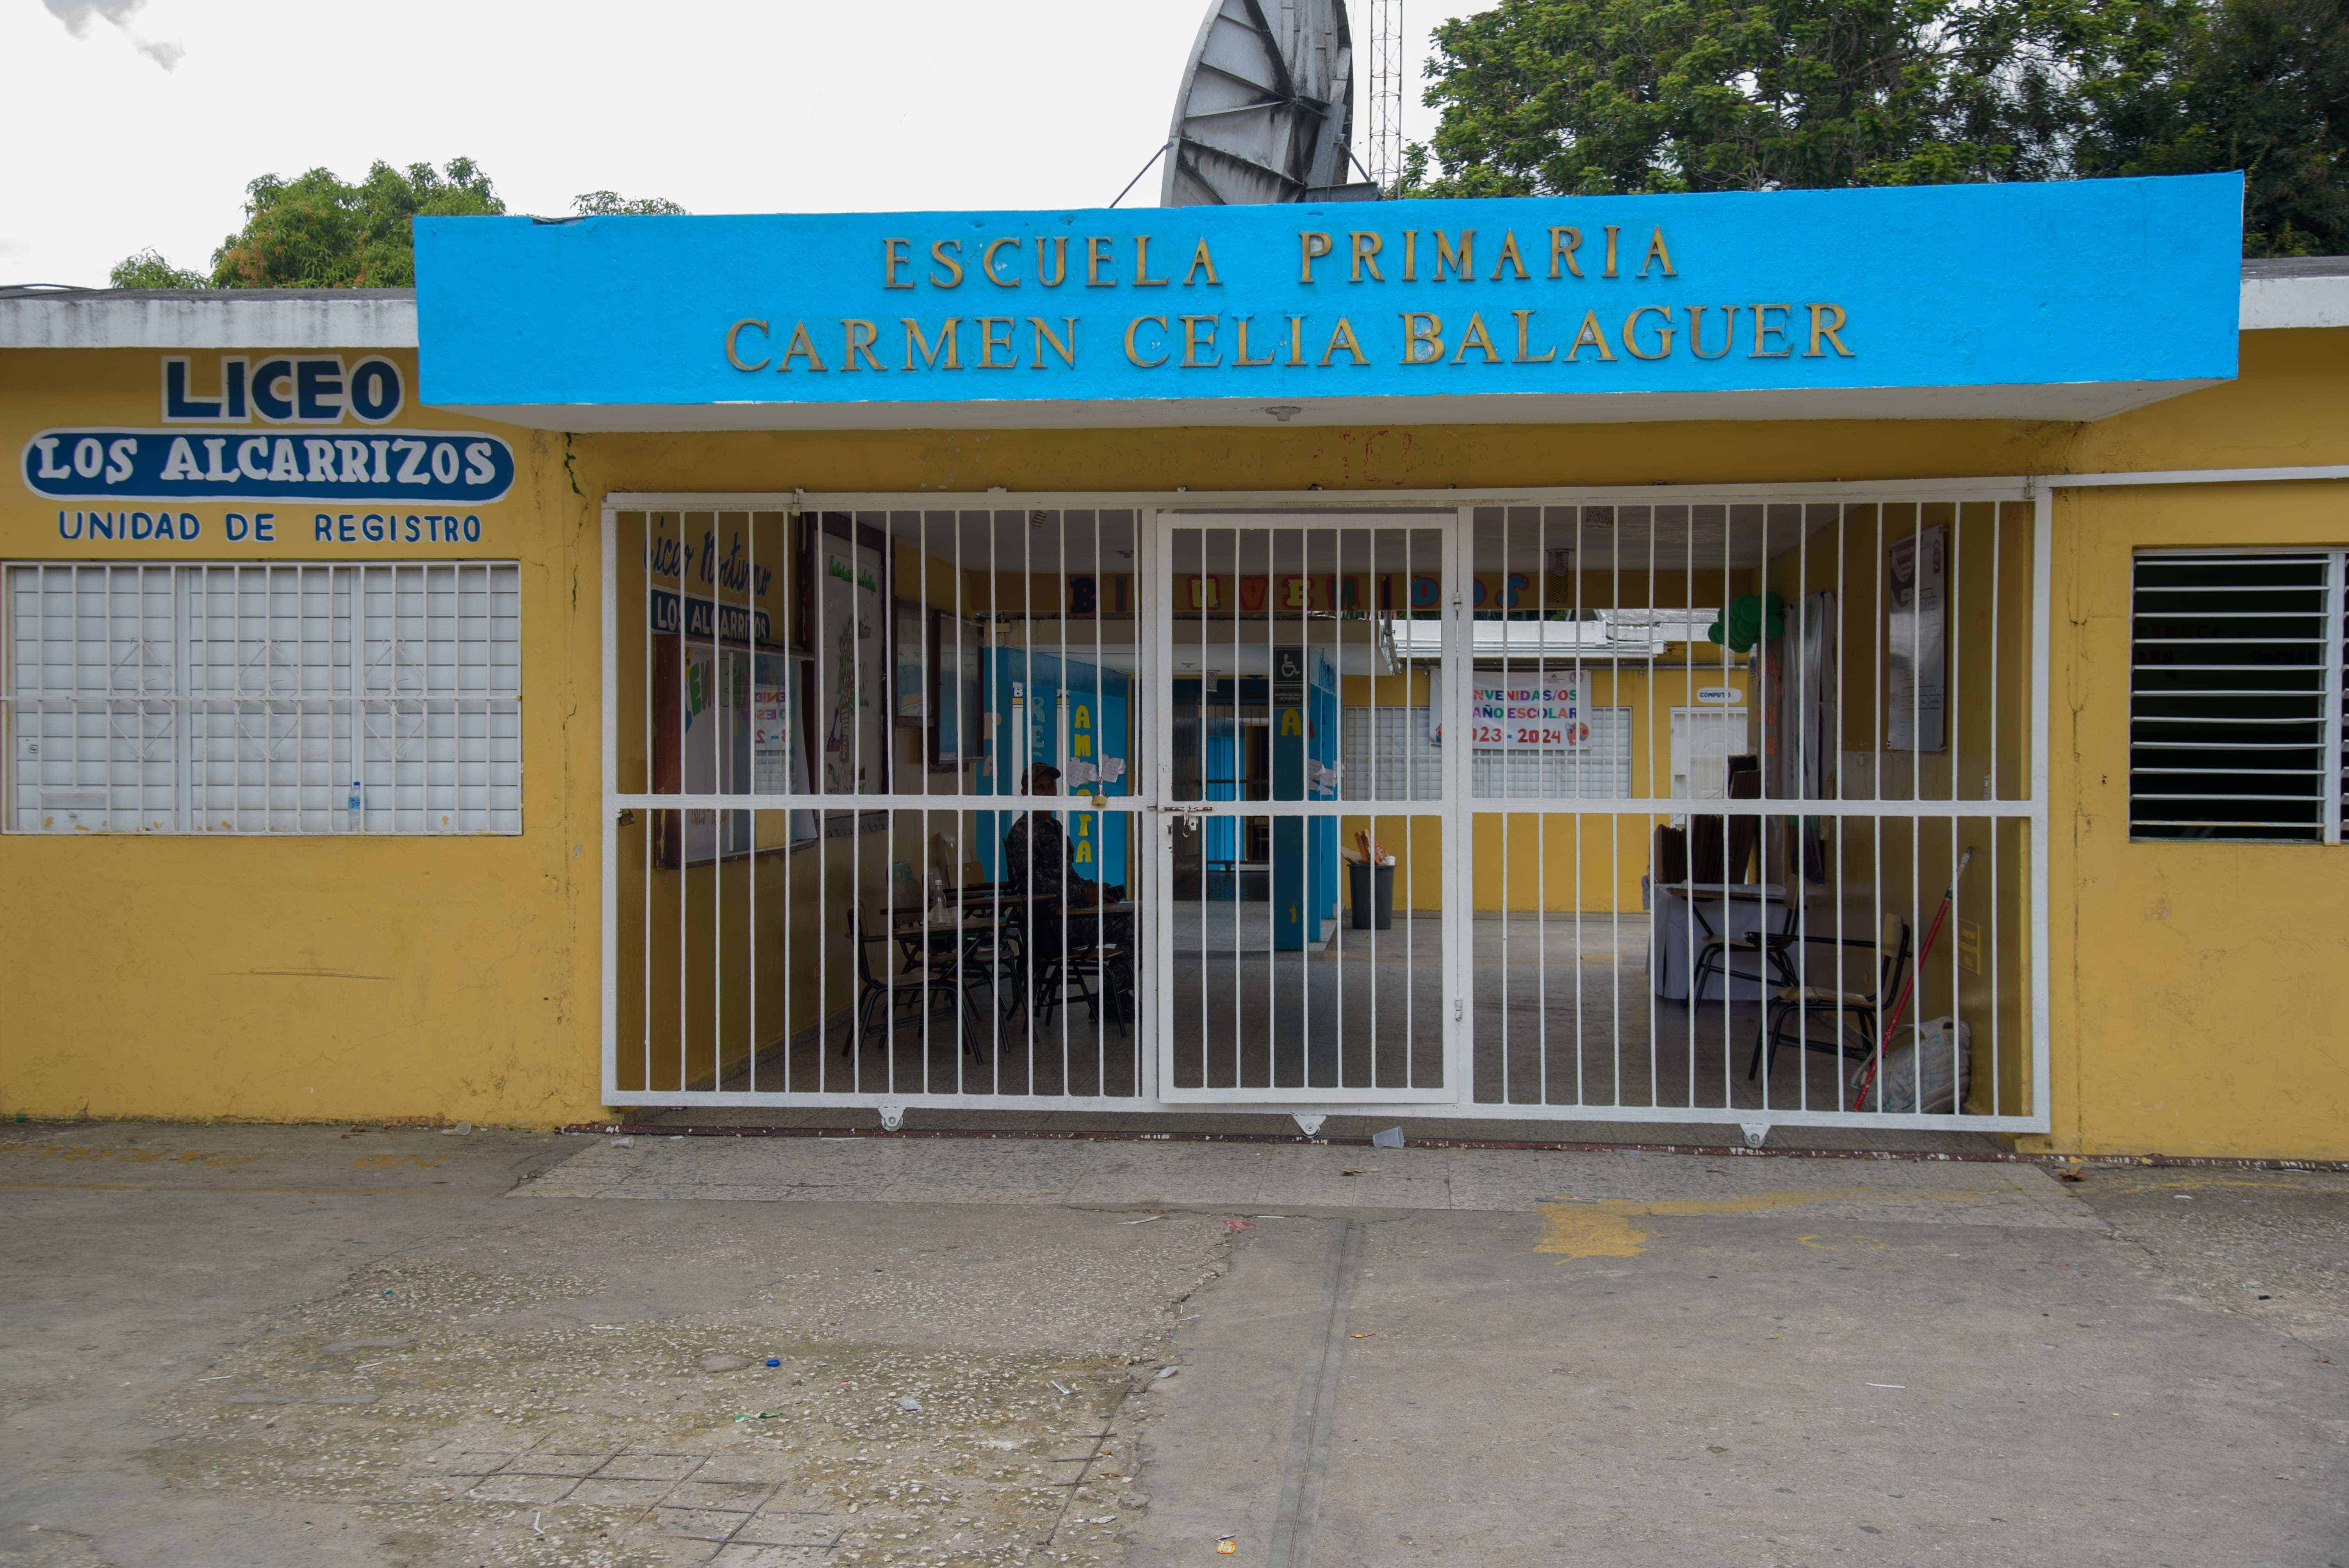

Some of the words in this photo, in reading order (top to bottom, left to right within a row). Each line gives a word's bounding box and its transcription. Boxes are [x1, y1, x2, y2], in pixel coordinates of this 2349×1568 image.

[883, 236, 1222, 289] ESCUELA
[1299, 226, 1677, 283] PRIMARIA
[725, 317, 1078, 372] CARMEN
[1124, 315, 1370, 368] CELIA
[1400, 303, 1855, 364] BALAGUER
[165, 358, 402, 422] LICEO
[36, 437, 137, 484] LOS
[160, 437, 495, 485] ALCARRIZOS
[59, 511, 201, 541] UNIDAD
[225, 513, 275, 542] DE
[315, 514, 481, 542] REGISTRO
[1473, 689, 1577, 701] NVENIDAS/OS
[1473, 704, 1503, 718] AÑO
[1507, 707, 1577, 718] ESCOLAR
[1473, 727, 1502, 741] 23
[1518, 729, 1561, 743] 2024
